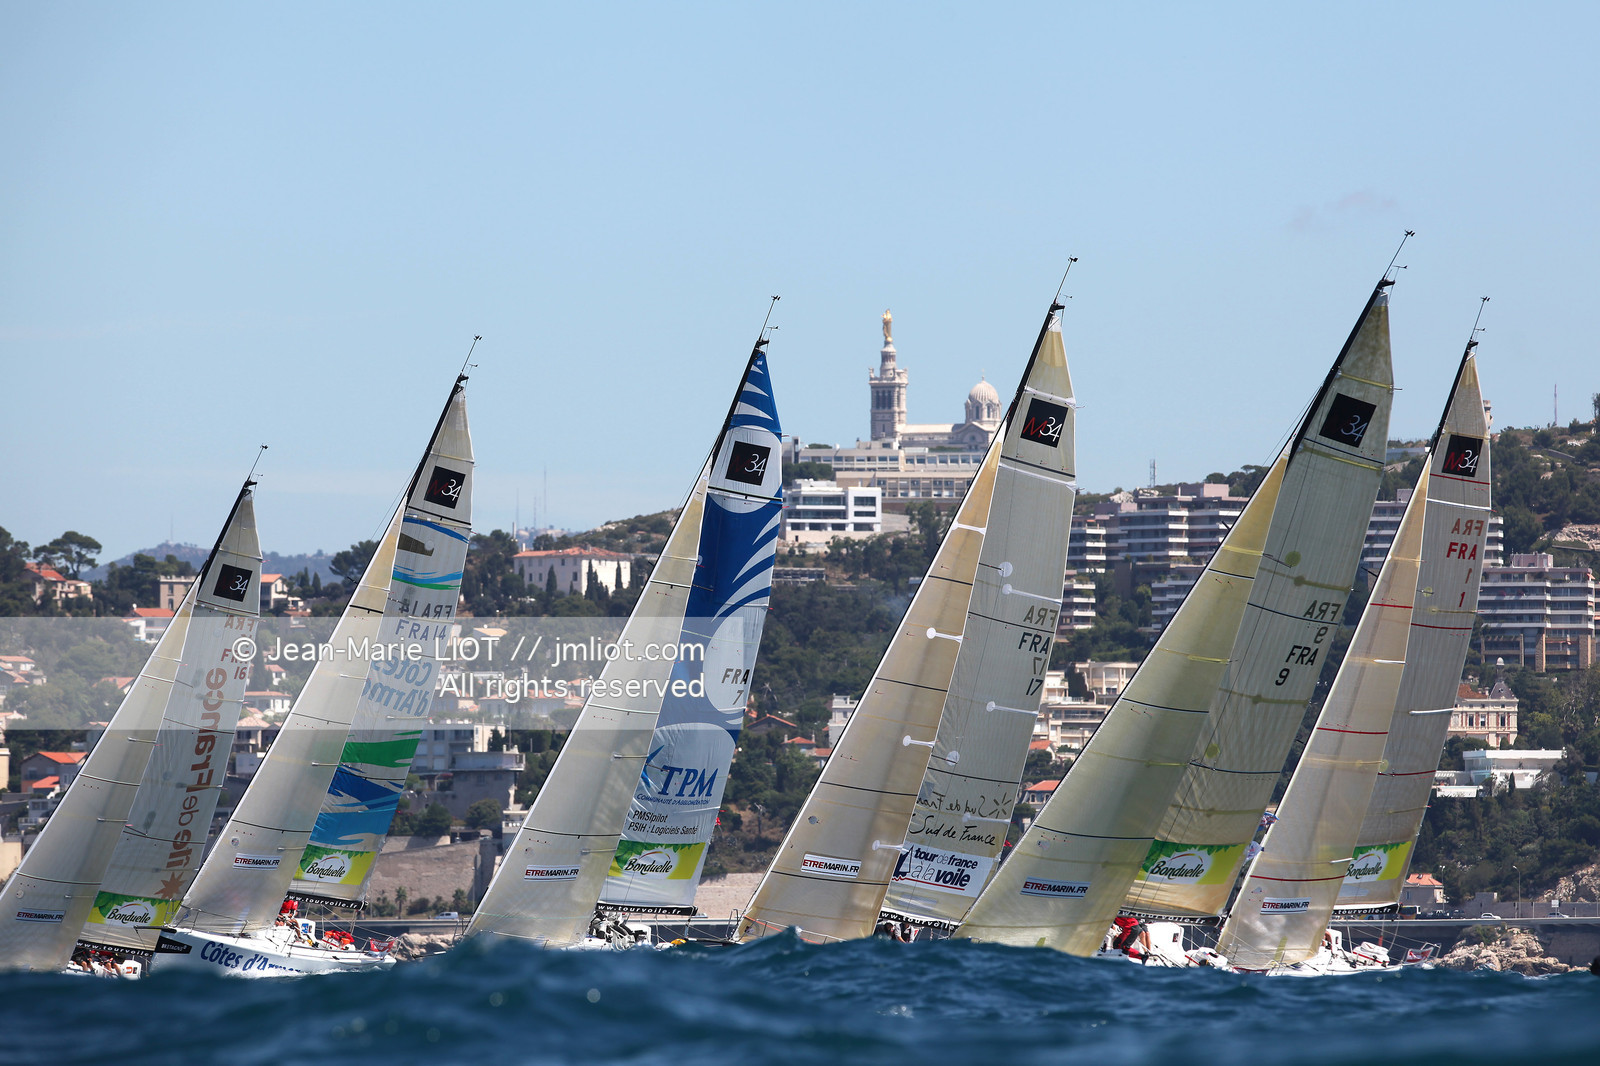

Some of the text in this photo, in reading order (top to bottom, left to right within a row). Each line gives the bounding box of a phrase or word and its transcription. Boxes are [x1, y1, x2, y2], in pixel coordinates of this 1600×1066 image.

[1023, 416, 1063, 442] M34
[1444, 449, 1479, 473] M34
[427, 478, 462, 501] M34
[1446, 542, 1478, 561] FRA
[1458, 591, 1466, 608] 1
[395, 618, 448, 640] FRA 14
[1018, 631, 1051, 655] FRA
[1285, 645, 1319, 666] FRA
[233, 666, 248, 680] 16
[721, 668, 750, 685] FRA
[1275, 668, 1290, 686] 9
[1025, 678, 1044, 696] 17
[732, 689, 745, 706] 7
[657, 764, 719, 798] TPM
[627, 821, 646, 833] PSIH
[651, 824, 681, 837] Logiciels
[681, 824, 699, 836] Santé
[908, 815, 995, 846] Sud de France
[234, 857, 281, 866] ETREMARIN.FR
[802, 859, 860, 874] ETREMARIN.FR
[914, 847, 938, 861] tour
[947, 854, 979, 869] france
[306, 862, 346, 879] Bonduelle
[525, 868, 580, 877] ETREMARIN.FR
[625, 858, 673, 876] Bonduelle
[1150, 860, 1204, 880] Bonduelle
[1345, 862, 1382, 879] Bonduelle
[935, 868, 971, 887] voile
[1023, 881, 1088, 894] ETREMARIN.FR
[1262, 901, 1310, 909] ETREMARIN.FR
[1331, 907, 1392, 916] .tourvoile.fr
[16, 911, 64, 920] ETREMARIN.FR
[107, 908, 151, 924] Bonduelle
[1118, 910, 1206, 925] w.tourvoile.fr
[200, 940, 243, 969] Côtes
